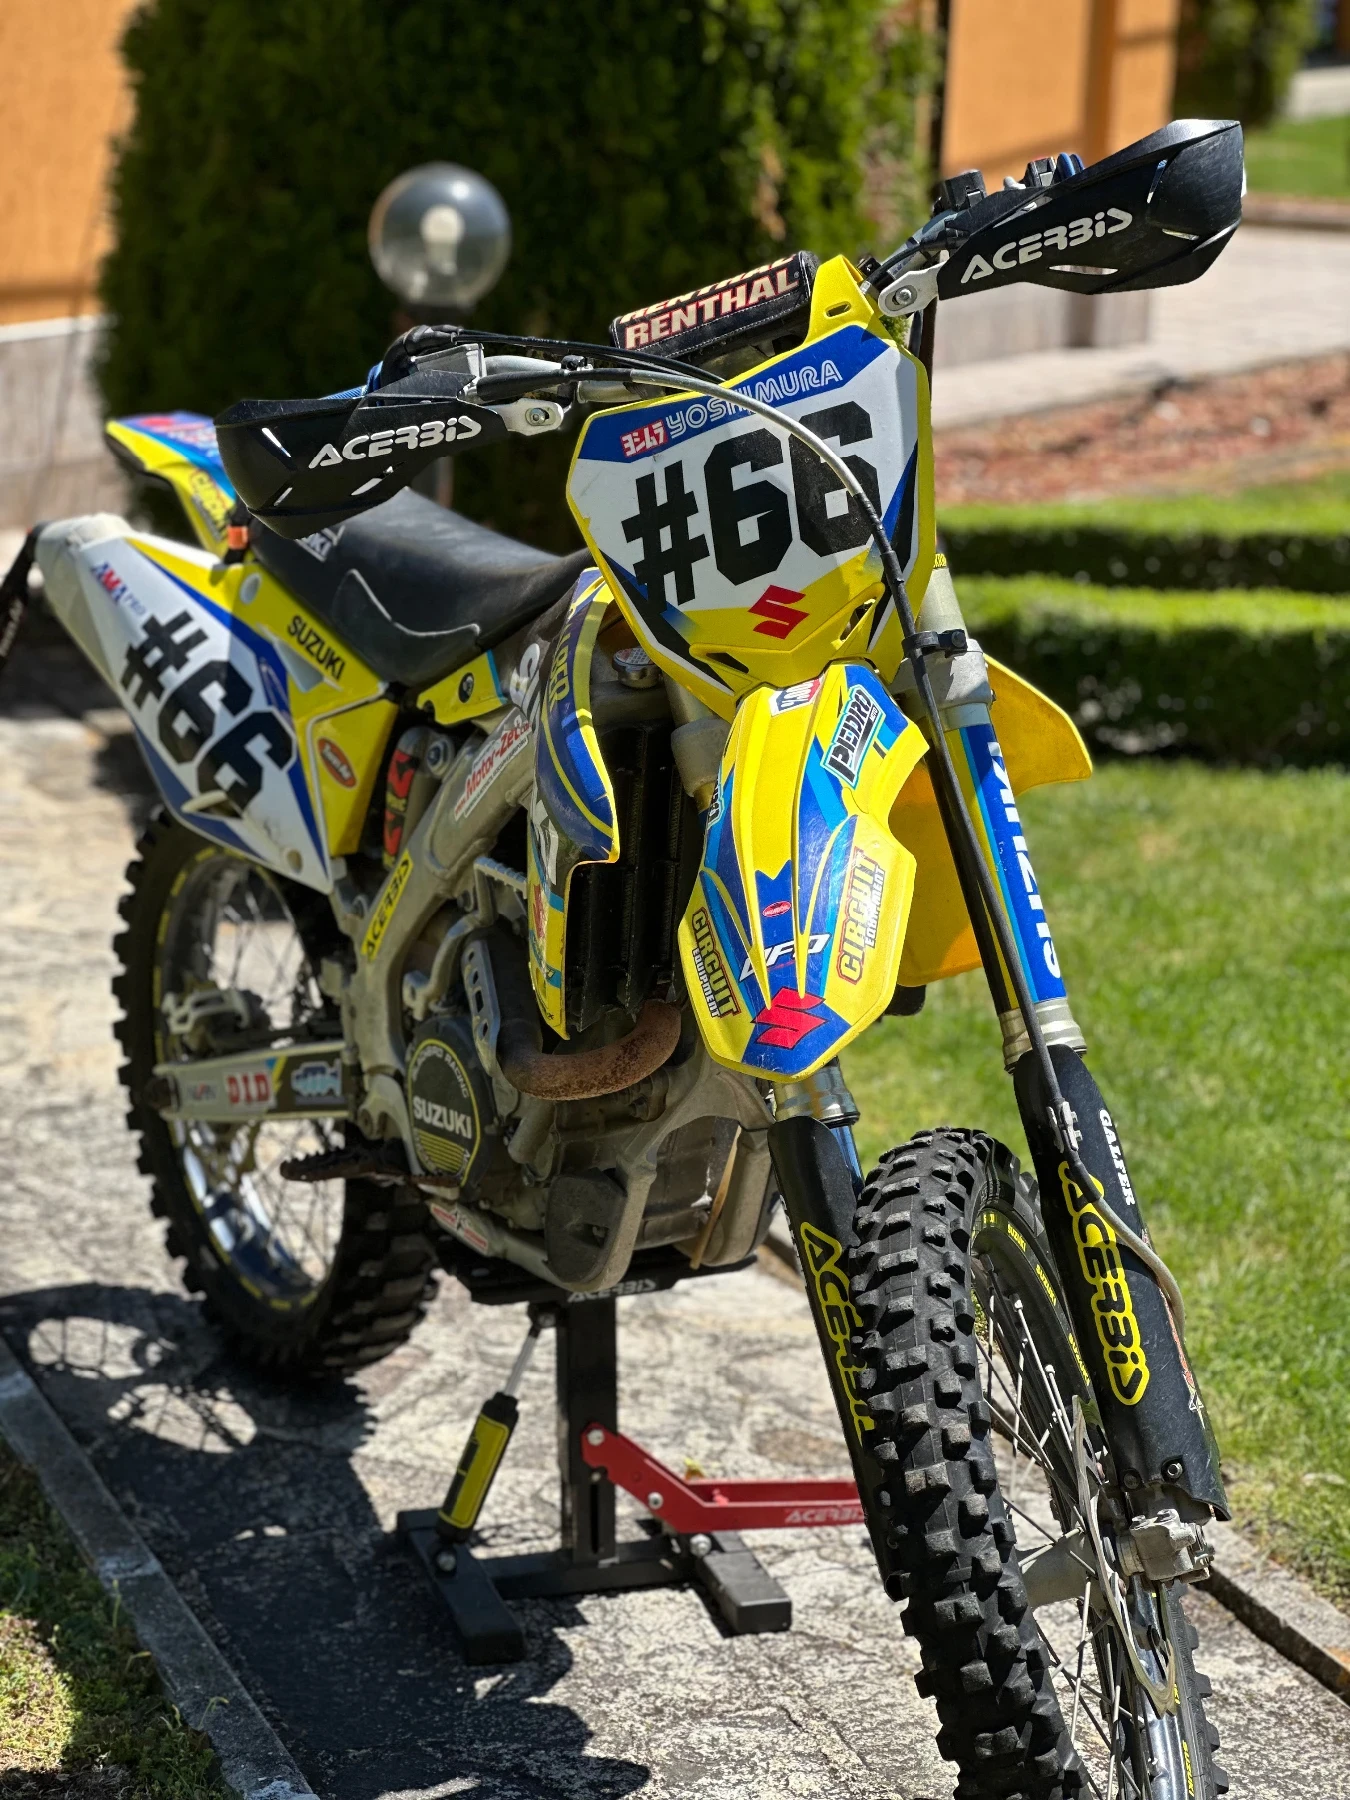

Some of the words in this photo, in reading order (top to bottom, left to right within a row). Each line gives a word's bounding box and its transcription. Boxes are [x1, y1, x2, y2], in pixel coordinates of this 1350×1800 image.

[960, 207, 1133, 284] ACERBIS
[625, 267, 800, 350] RENTHAL
[665, 359, 843, 439] YOSHIMURA
[308, 415, 482, 470] ACERBIS
[621, 420, 667, 457] ヨシムラ
[620, 401, 883, 613] #66
[287, 615, 346, 681] SUZUKI
[120, 609, 293, 818] #66
[827, 689, 873, 784] PEDRO
[837, 848, 878, 985] CIRCUIT
[692, 907, 740, 1017] CIRCUIT
[692, 947, 721, 1017] EQUIPMENT
[413, 1095, 473, 1140] SUZUKI
[1099, 1108, 1136, 1206] GALFER
[1007, 1223, 1027, 1253] SUZUKI
[1035, 1263, 1057, 1307] SUZUKI
